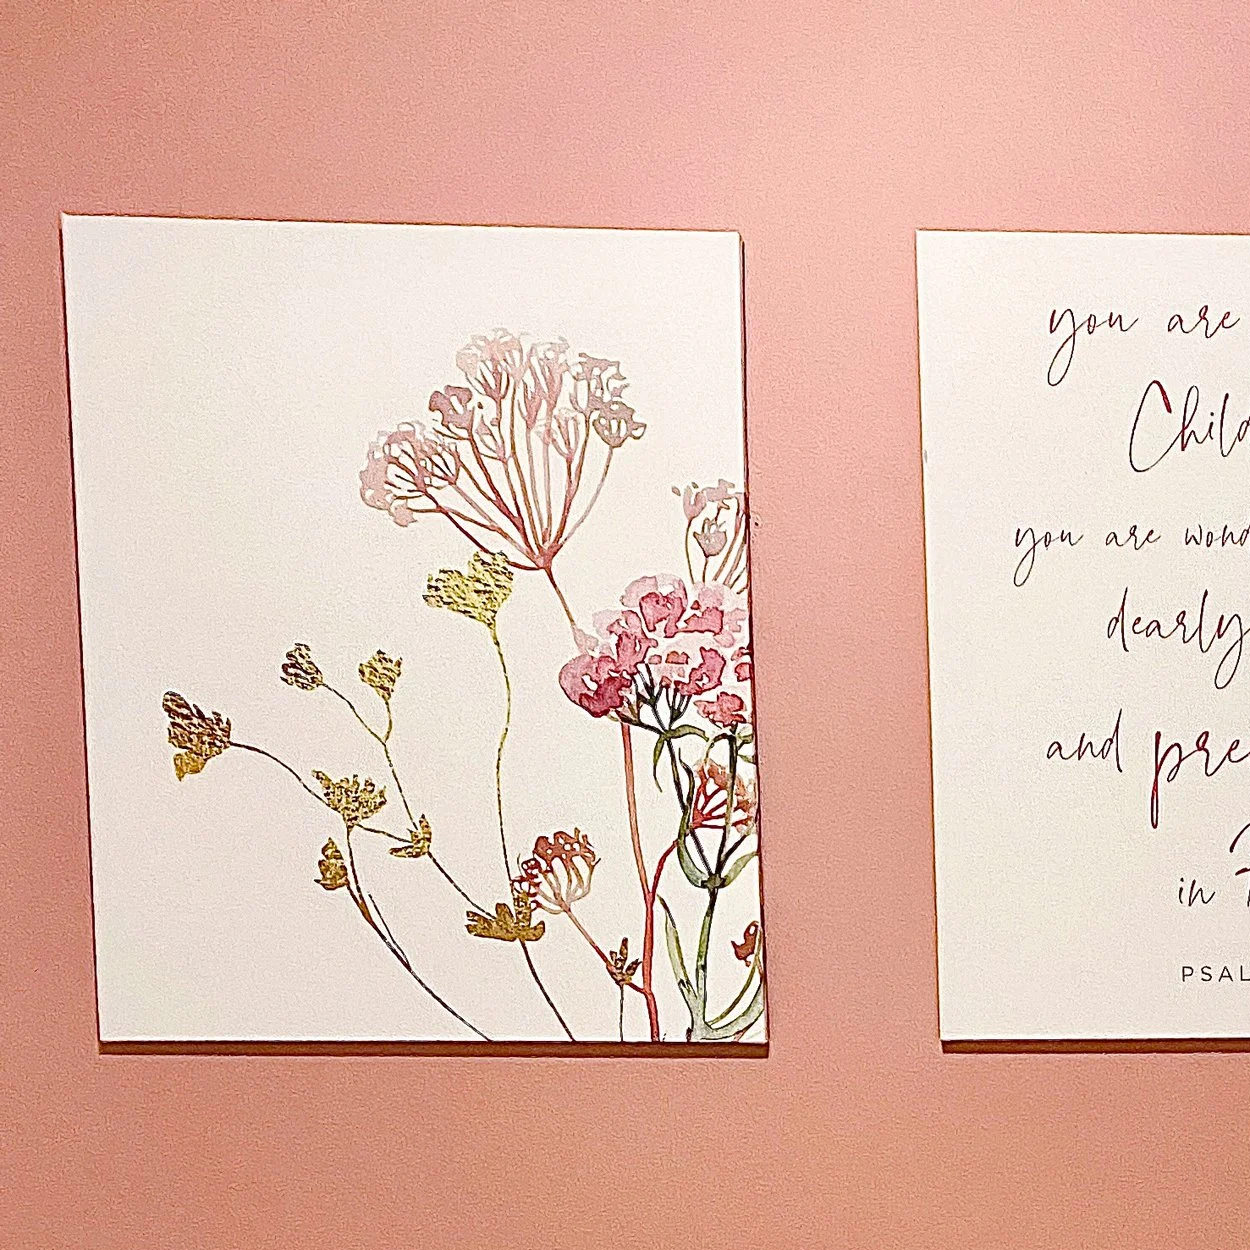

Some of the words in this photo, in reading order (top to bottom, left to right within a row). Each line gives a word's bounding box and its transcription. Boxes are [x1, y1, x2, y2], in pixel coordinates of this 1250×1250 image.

[1047, 305, 1138, 387] you
[1168, 305, 1240, 338] are
[1014, 526, 1083, 587] you
[1106, 525, 1160, 550] are
[1047, 709, 1122, 773] and
[1179, 878, 1215, 907] in
